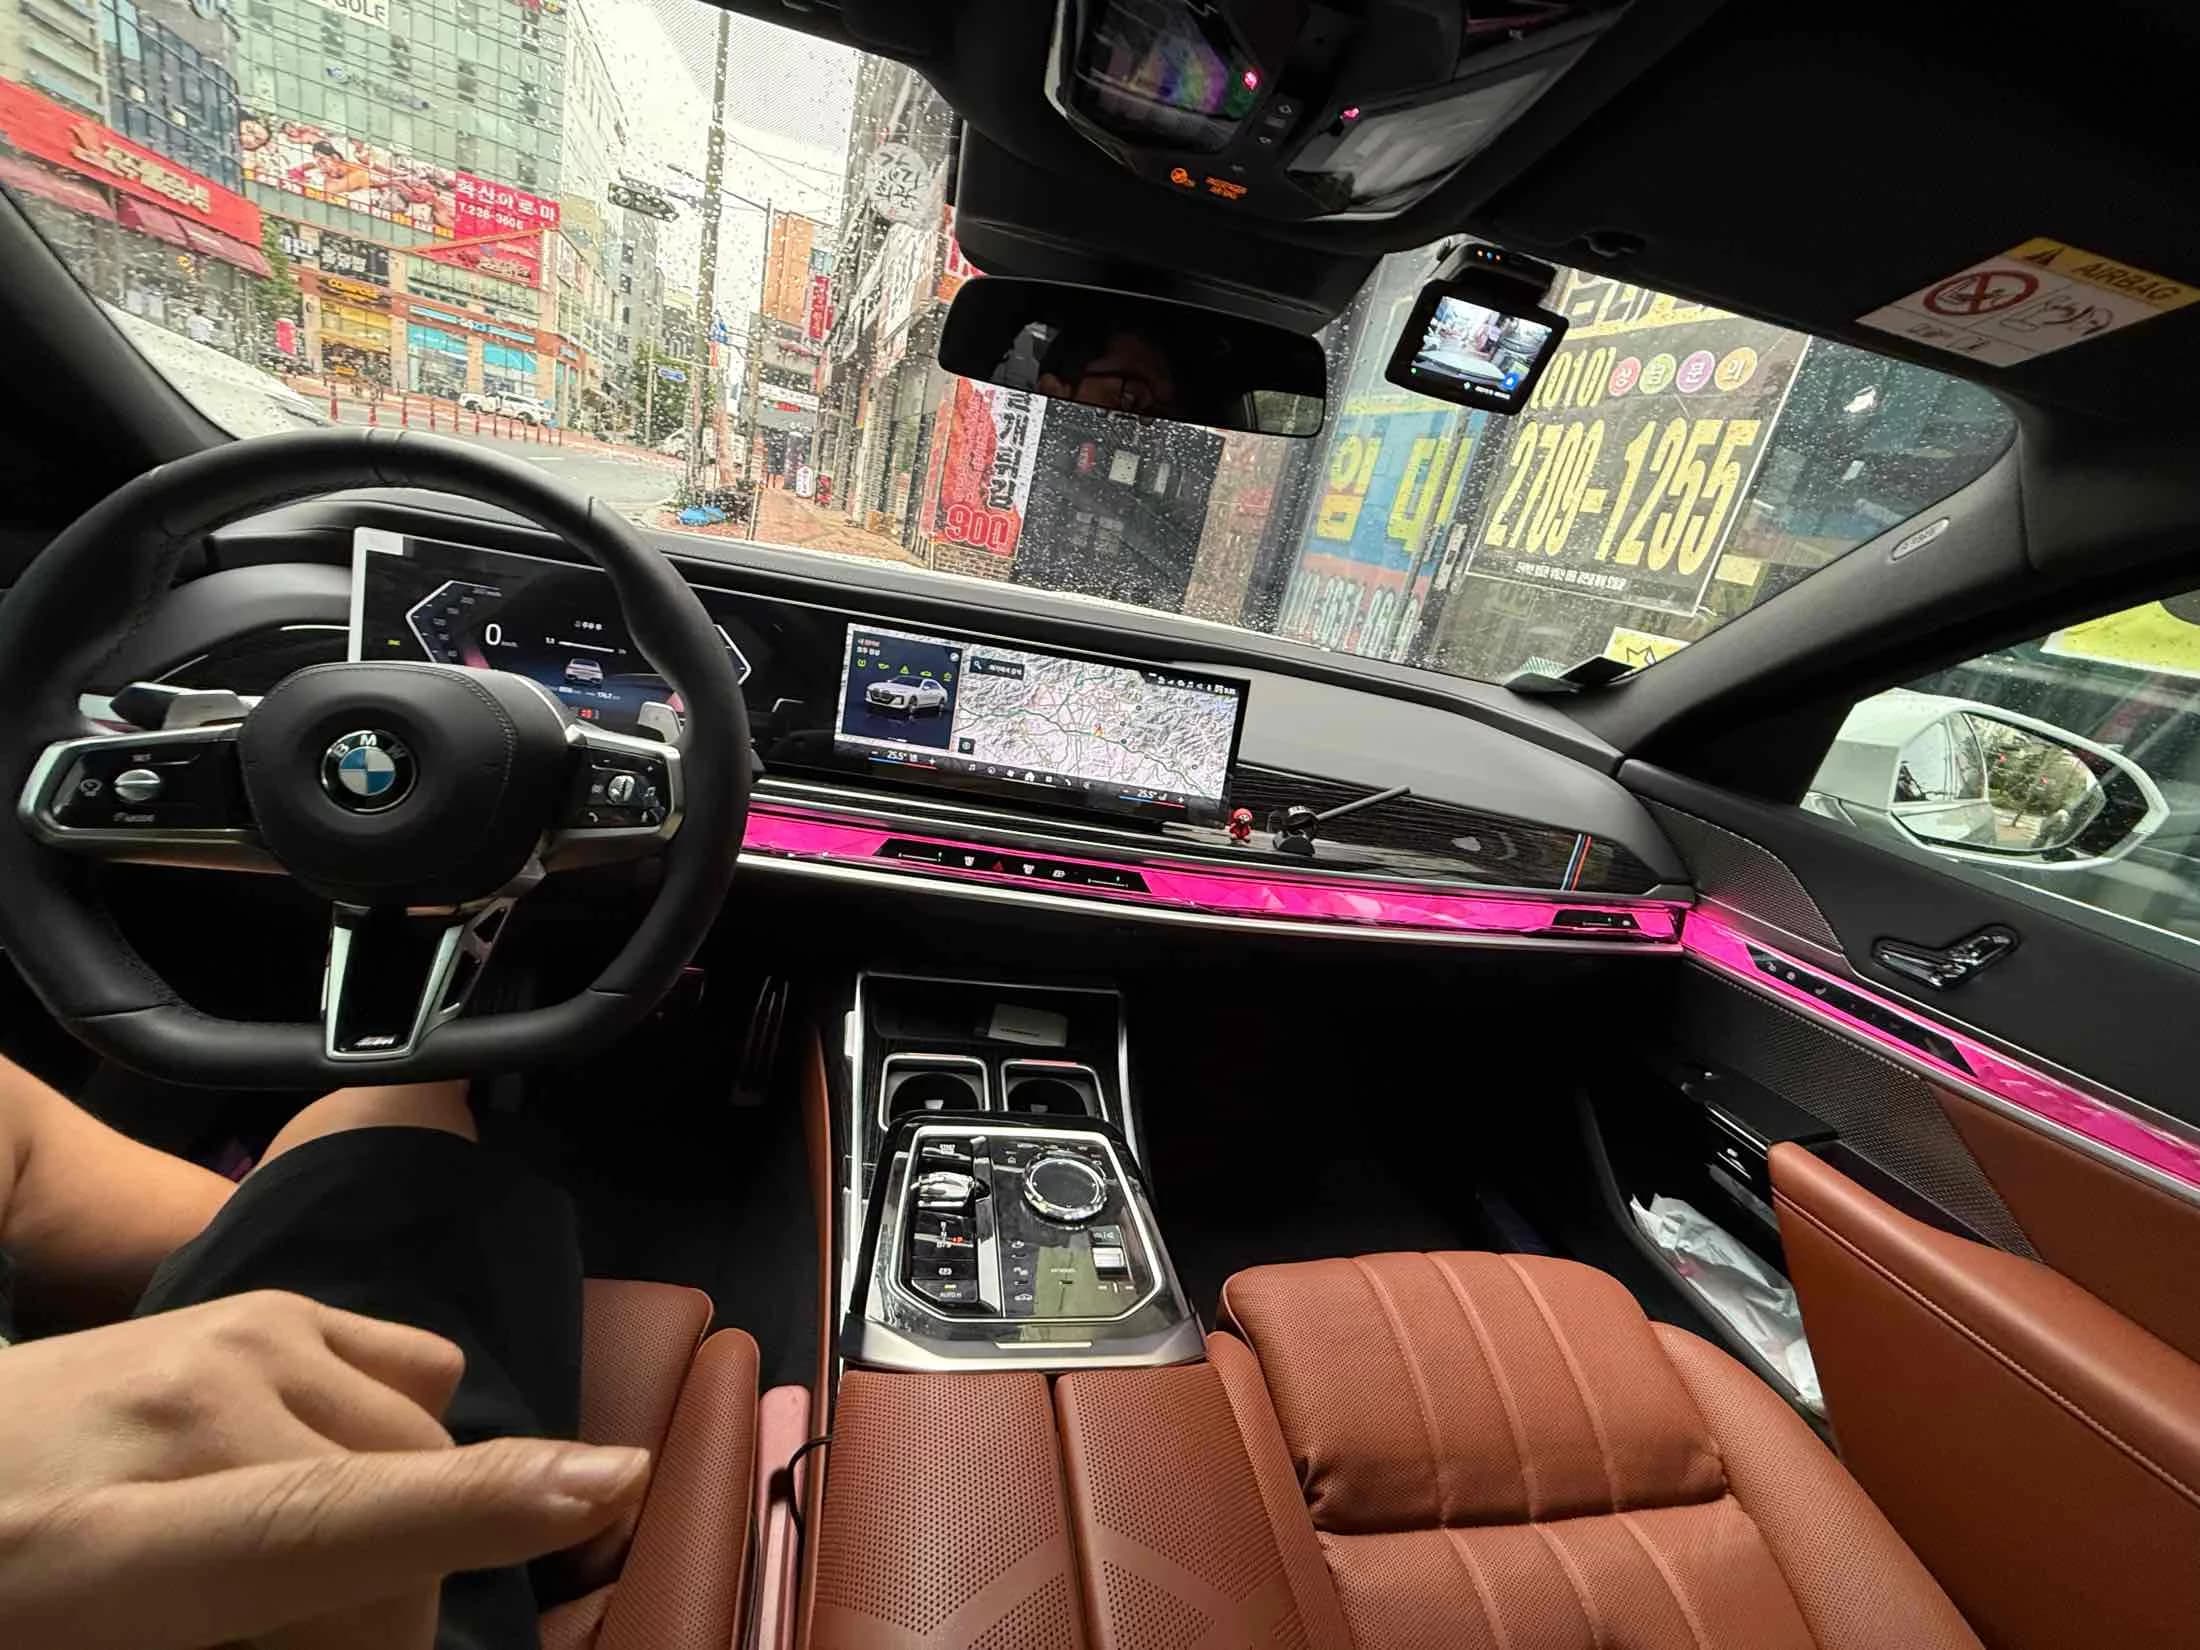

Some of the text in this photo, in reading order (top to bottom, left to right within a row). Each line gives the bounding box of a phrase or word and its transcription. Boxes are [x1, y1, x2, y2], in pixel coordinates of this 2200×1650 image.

[2073, 262, 2182, 302] AIRBAG
[1484, 417, 1761, 576] 2709-1255
[485, 623, 502, 646] 0
[334, 733, 408, 759] BMW
